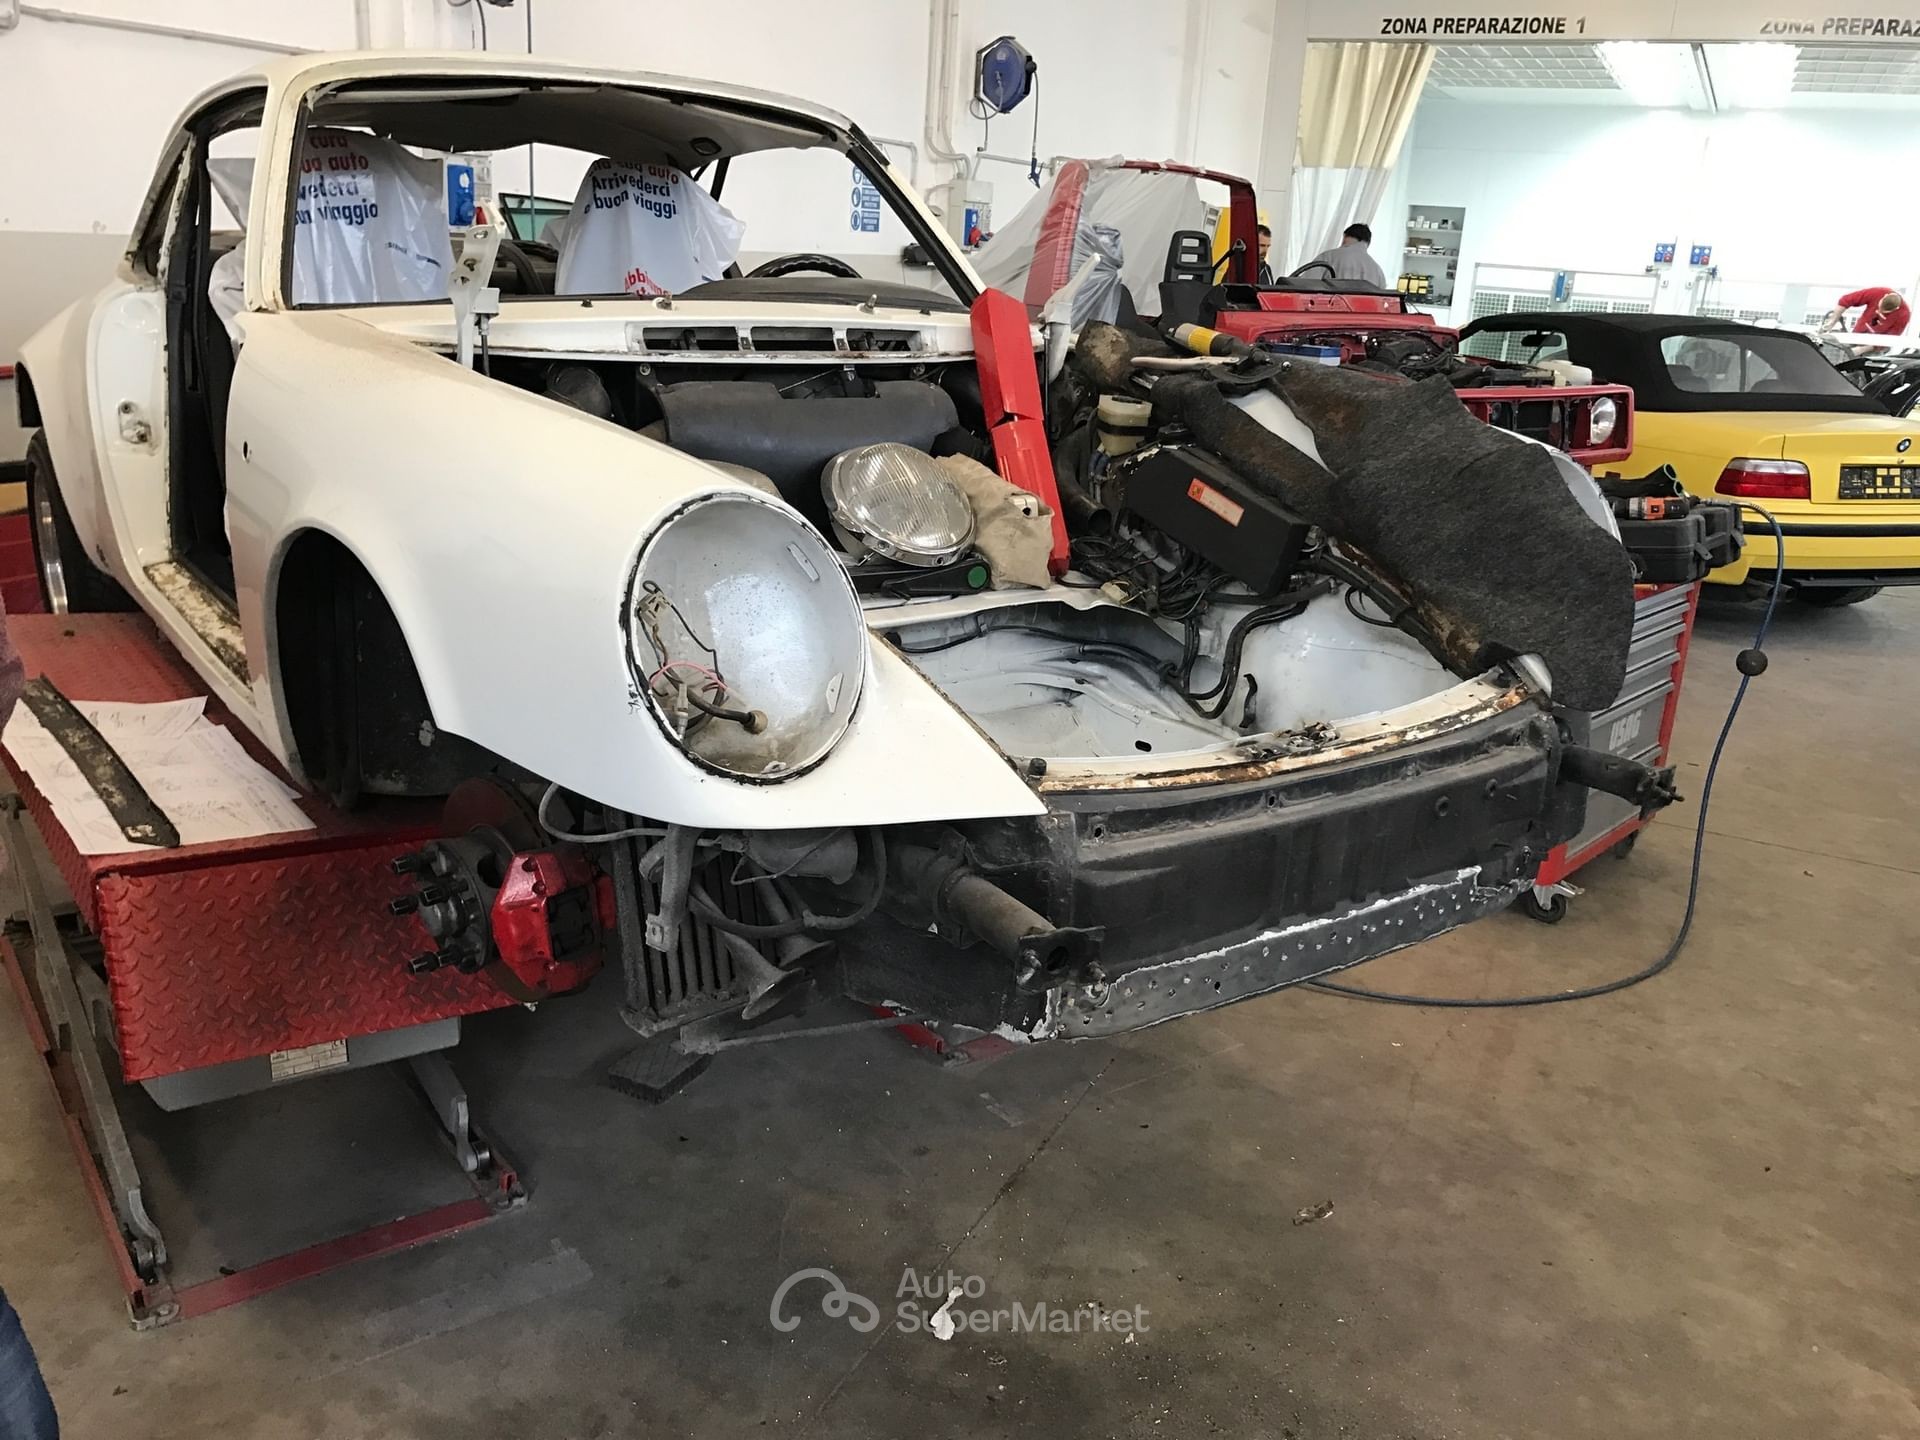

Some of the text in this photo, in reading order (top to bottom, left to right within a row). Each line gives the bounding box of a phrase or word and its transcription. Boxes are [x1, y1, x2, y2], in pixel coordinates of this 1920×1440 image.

[1381, 16, 1587, 35] ZONA PREPARAZIONE 1
[1759, 18, 1815, 35] ZONA
[301, 153, 369, 173] ua auto
[648, 165, 679, 184] auto
[297, 174, 359, 200] vederci
[592, 172, 671, 198] Arrivederci
[593, 189, 629, 209] buon
[317, 198, 378, 225] viaggio
